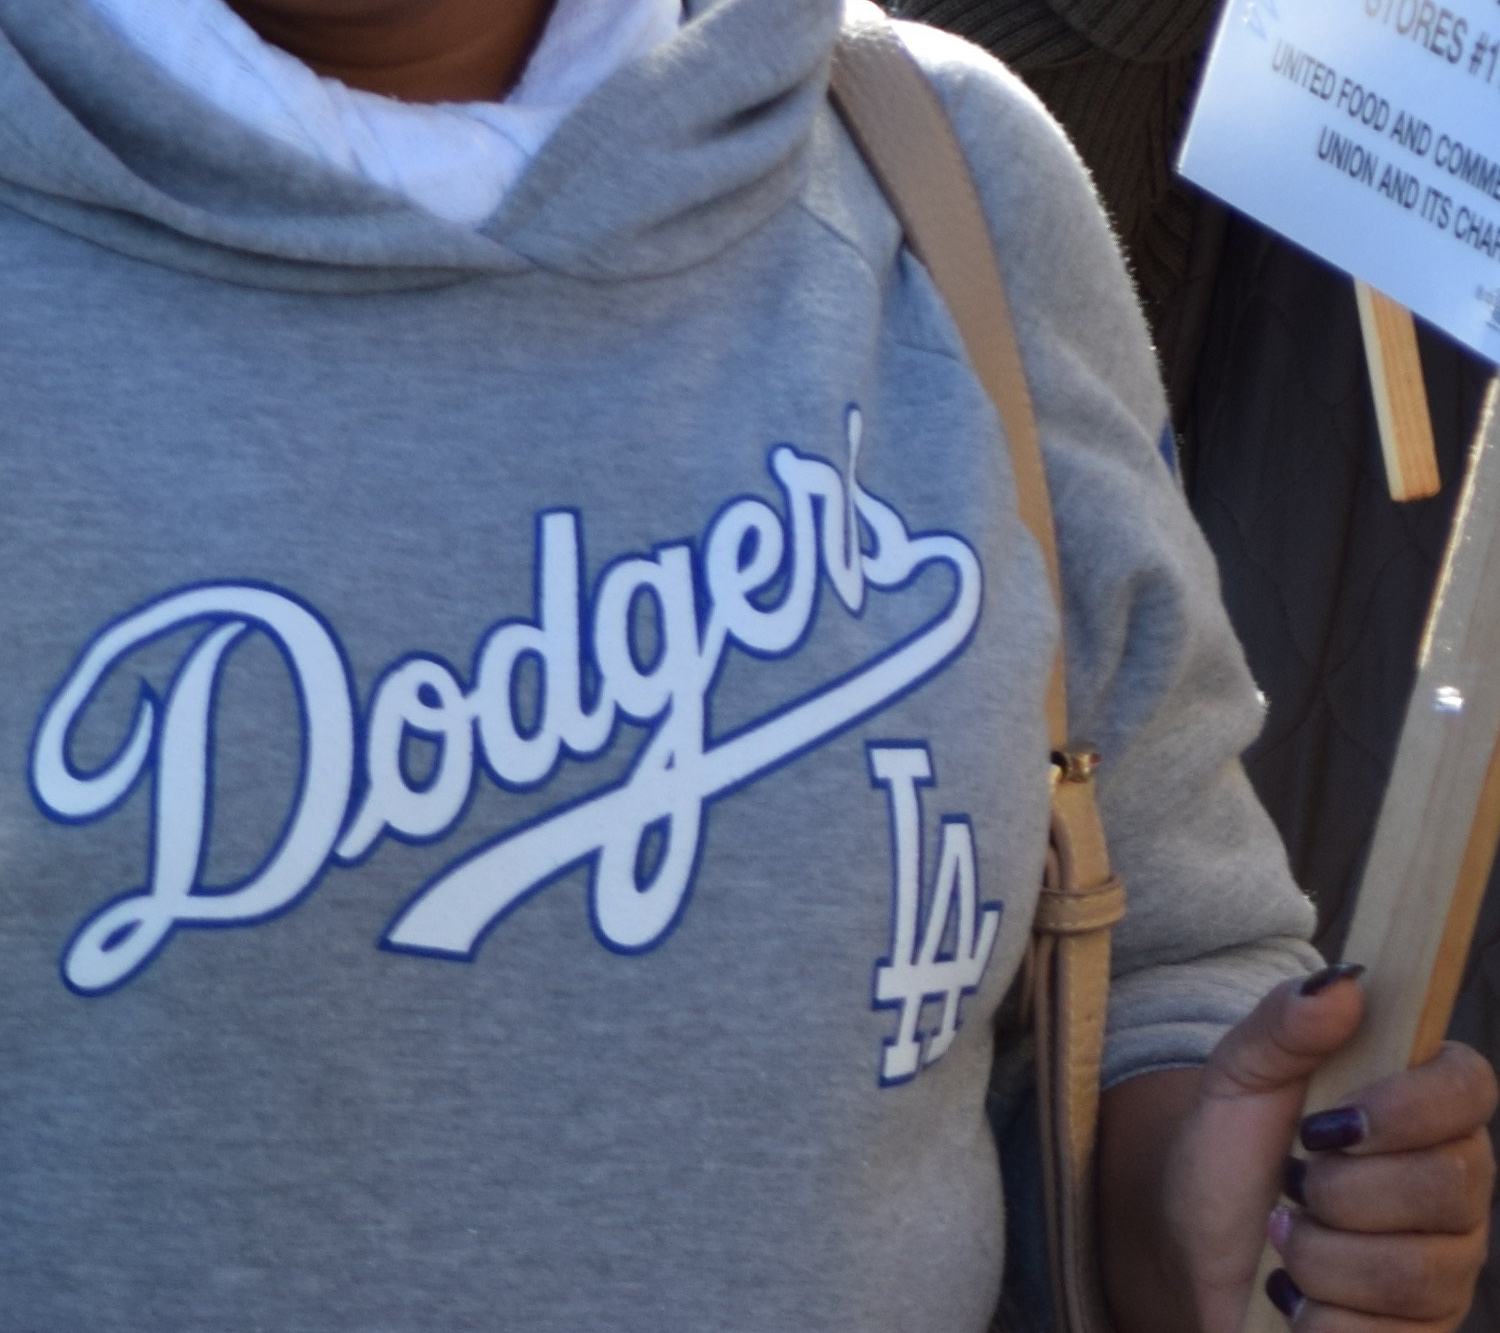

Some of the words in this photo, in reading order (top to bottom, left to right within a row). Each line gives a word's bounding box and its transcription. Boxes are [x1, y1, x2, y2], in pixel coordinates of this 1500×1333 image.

[1272, 52, 1337, 104] UNITED
[1337, 78, 1390, 133] FOOD
[1389, 111, 1432, 157] AND
[1317, 128, 1378, 187] UNION
[1379, 164, 1420, 210] AND
[1421, 186, 1453, 230] ITS
[31, 403, 983, 996] Dodgers
[865, 738, 1003, 1087] LA
